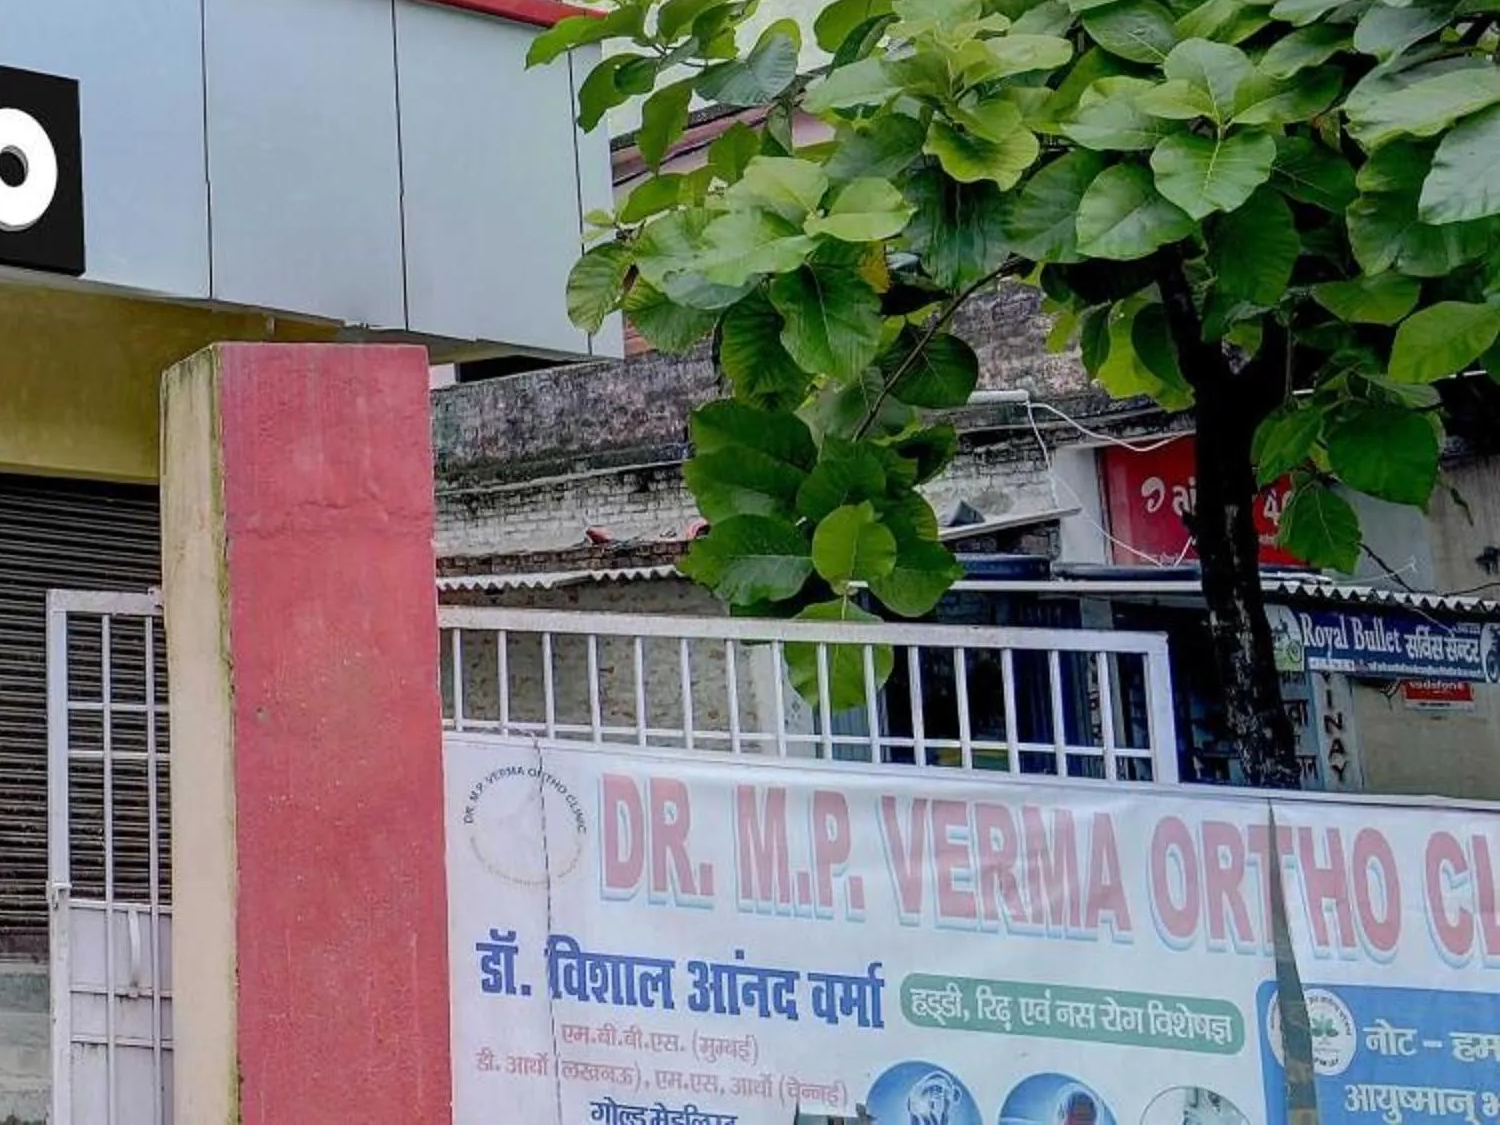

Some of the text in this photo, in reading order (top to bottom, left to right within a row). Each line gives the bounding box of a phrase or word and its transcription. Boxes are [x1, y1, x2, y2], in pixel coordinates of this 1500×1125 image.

[1300, 613, 1349, 658] Royal
[1352, 616, 1402, 653] Bullet
[1404, 625, 1444, 660] सर्विस
[564, 794, 588, 835] CLINIC
[600, 773, 714, 908] DR.
[735, 783, 866, 923] M.P.
[876, 794, 1133, 943] VERMA
[1150, 814, 1399, 965] ORTHO
[476, 929, 531, 995] डॉ.
[544, 933, 675, 1010] विशाल
[807, 962, 884, 1029] वर्मा
[1019, 989, 1051, 1026] एवं
[1055, 998, 1095, 1030] नस
[1099, 996, 1144, 1034] रोग
[1148, 999, 1233, 1045] विशेषज्ञ
[1363, 1018, 1418, 1056] नोट
